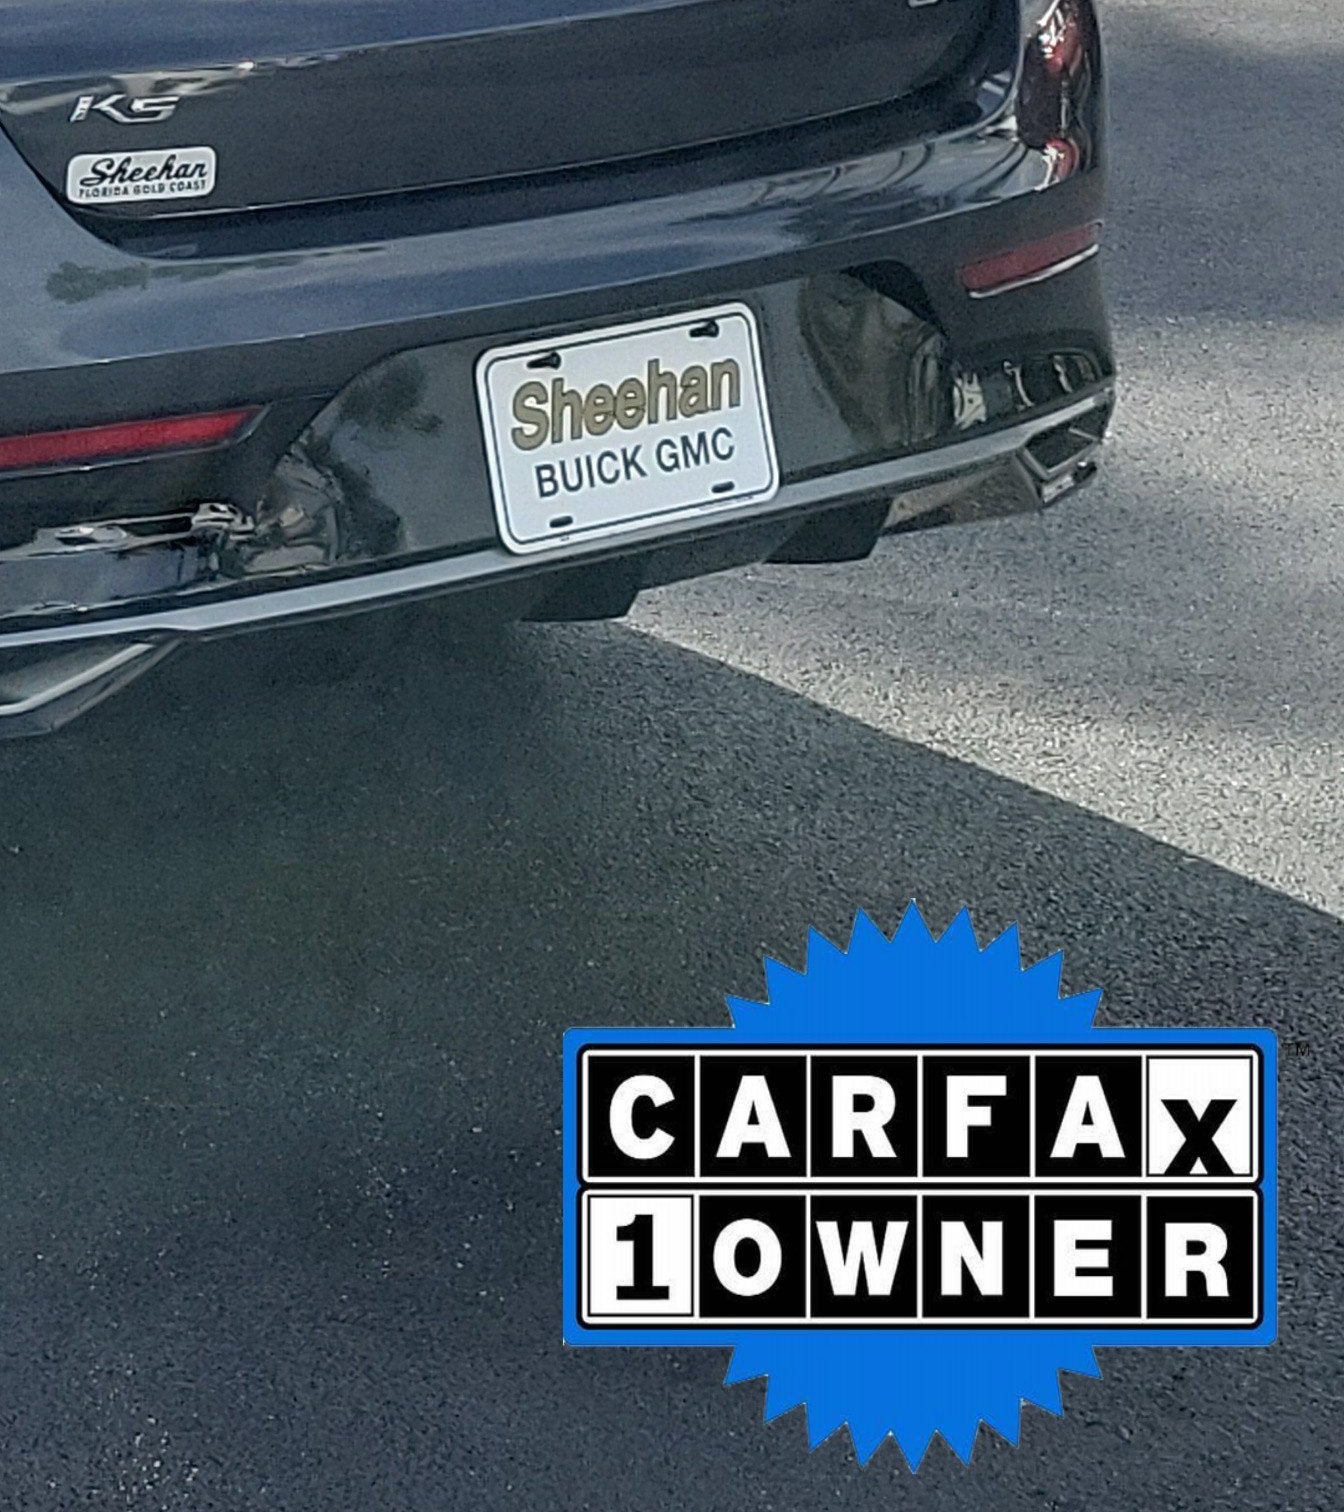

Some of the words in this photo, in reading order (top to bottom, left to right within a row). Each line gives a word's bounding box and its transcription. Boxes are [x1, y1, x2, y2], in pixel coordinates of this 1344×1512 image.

[79, 154, 208, 187] Sheehan
[79, 186, 129, 198] FLORIDA
[133, 183, 166, 195] GOLD
[170, 180, 206, 193] COAST
[511, 358, 741, 452] Sheehan
[535, 444, 648, 499] BUICK
[655, 427, 736, 474] GMC
